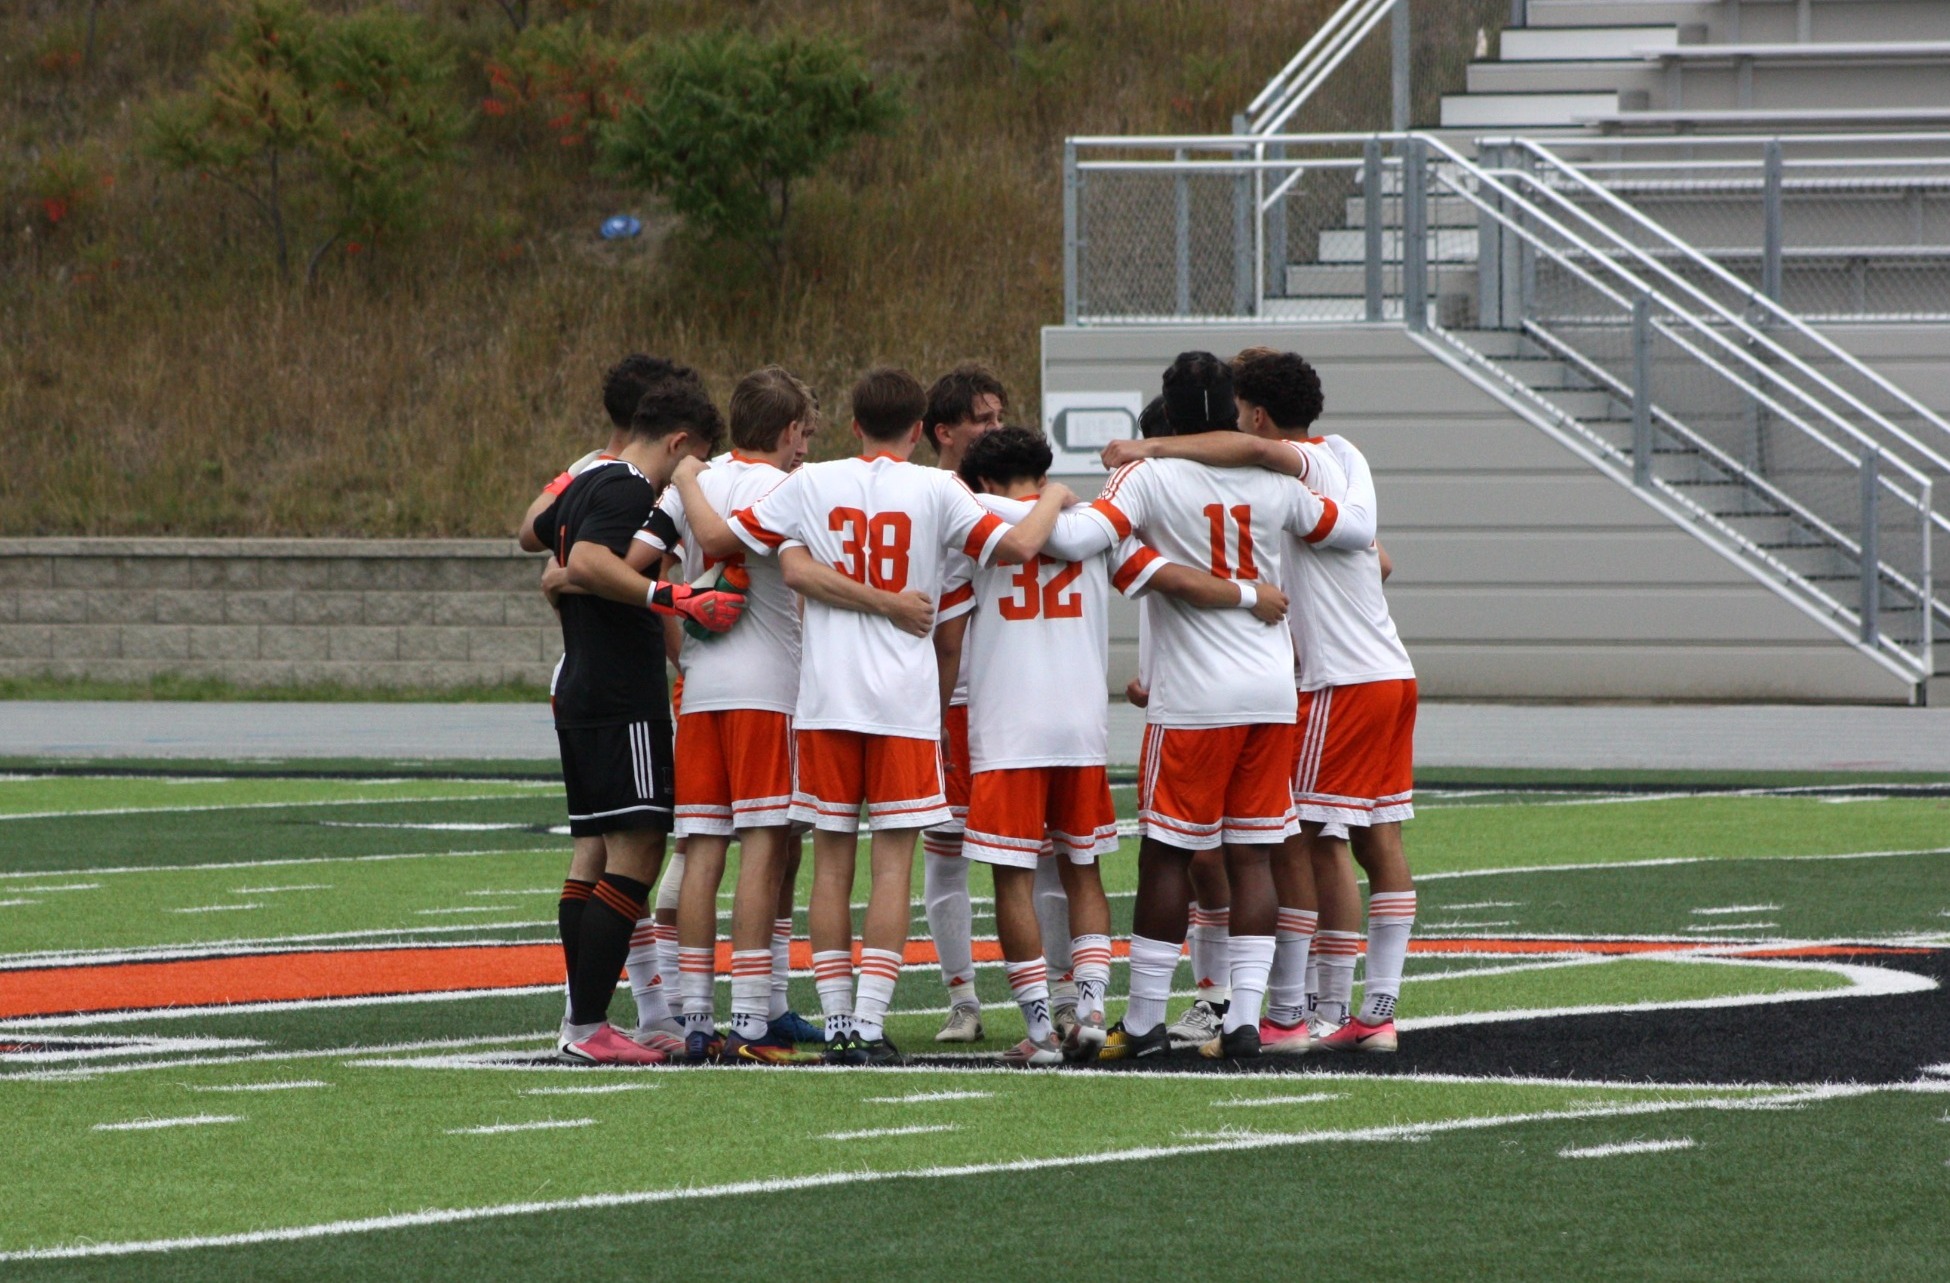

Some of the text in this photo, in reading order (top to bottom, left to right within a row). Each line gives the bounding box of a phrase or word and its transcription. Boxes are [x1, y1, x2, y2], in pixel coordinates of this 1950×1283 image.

[828, 506, 912, 593] 38
[1203, 503, 1259, 580] 11
[997, 553, 1083, 621] 32
